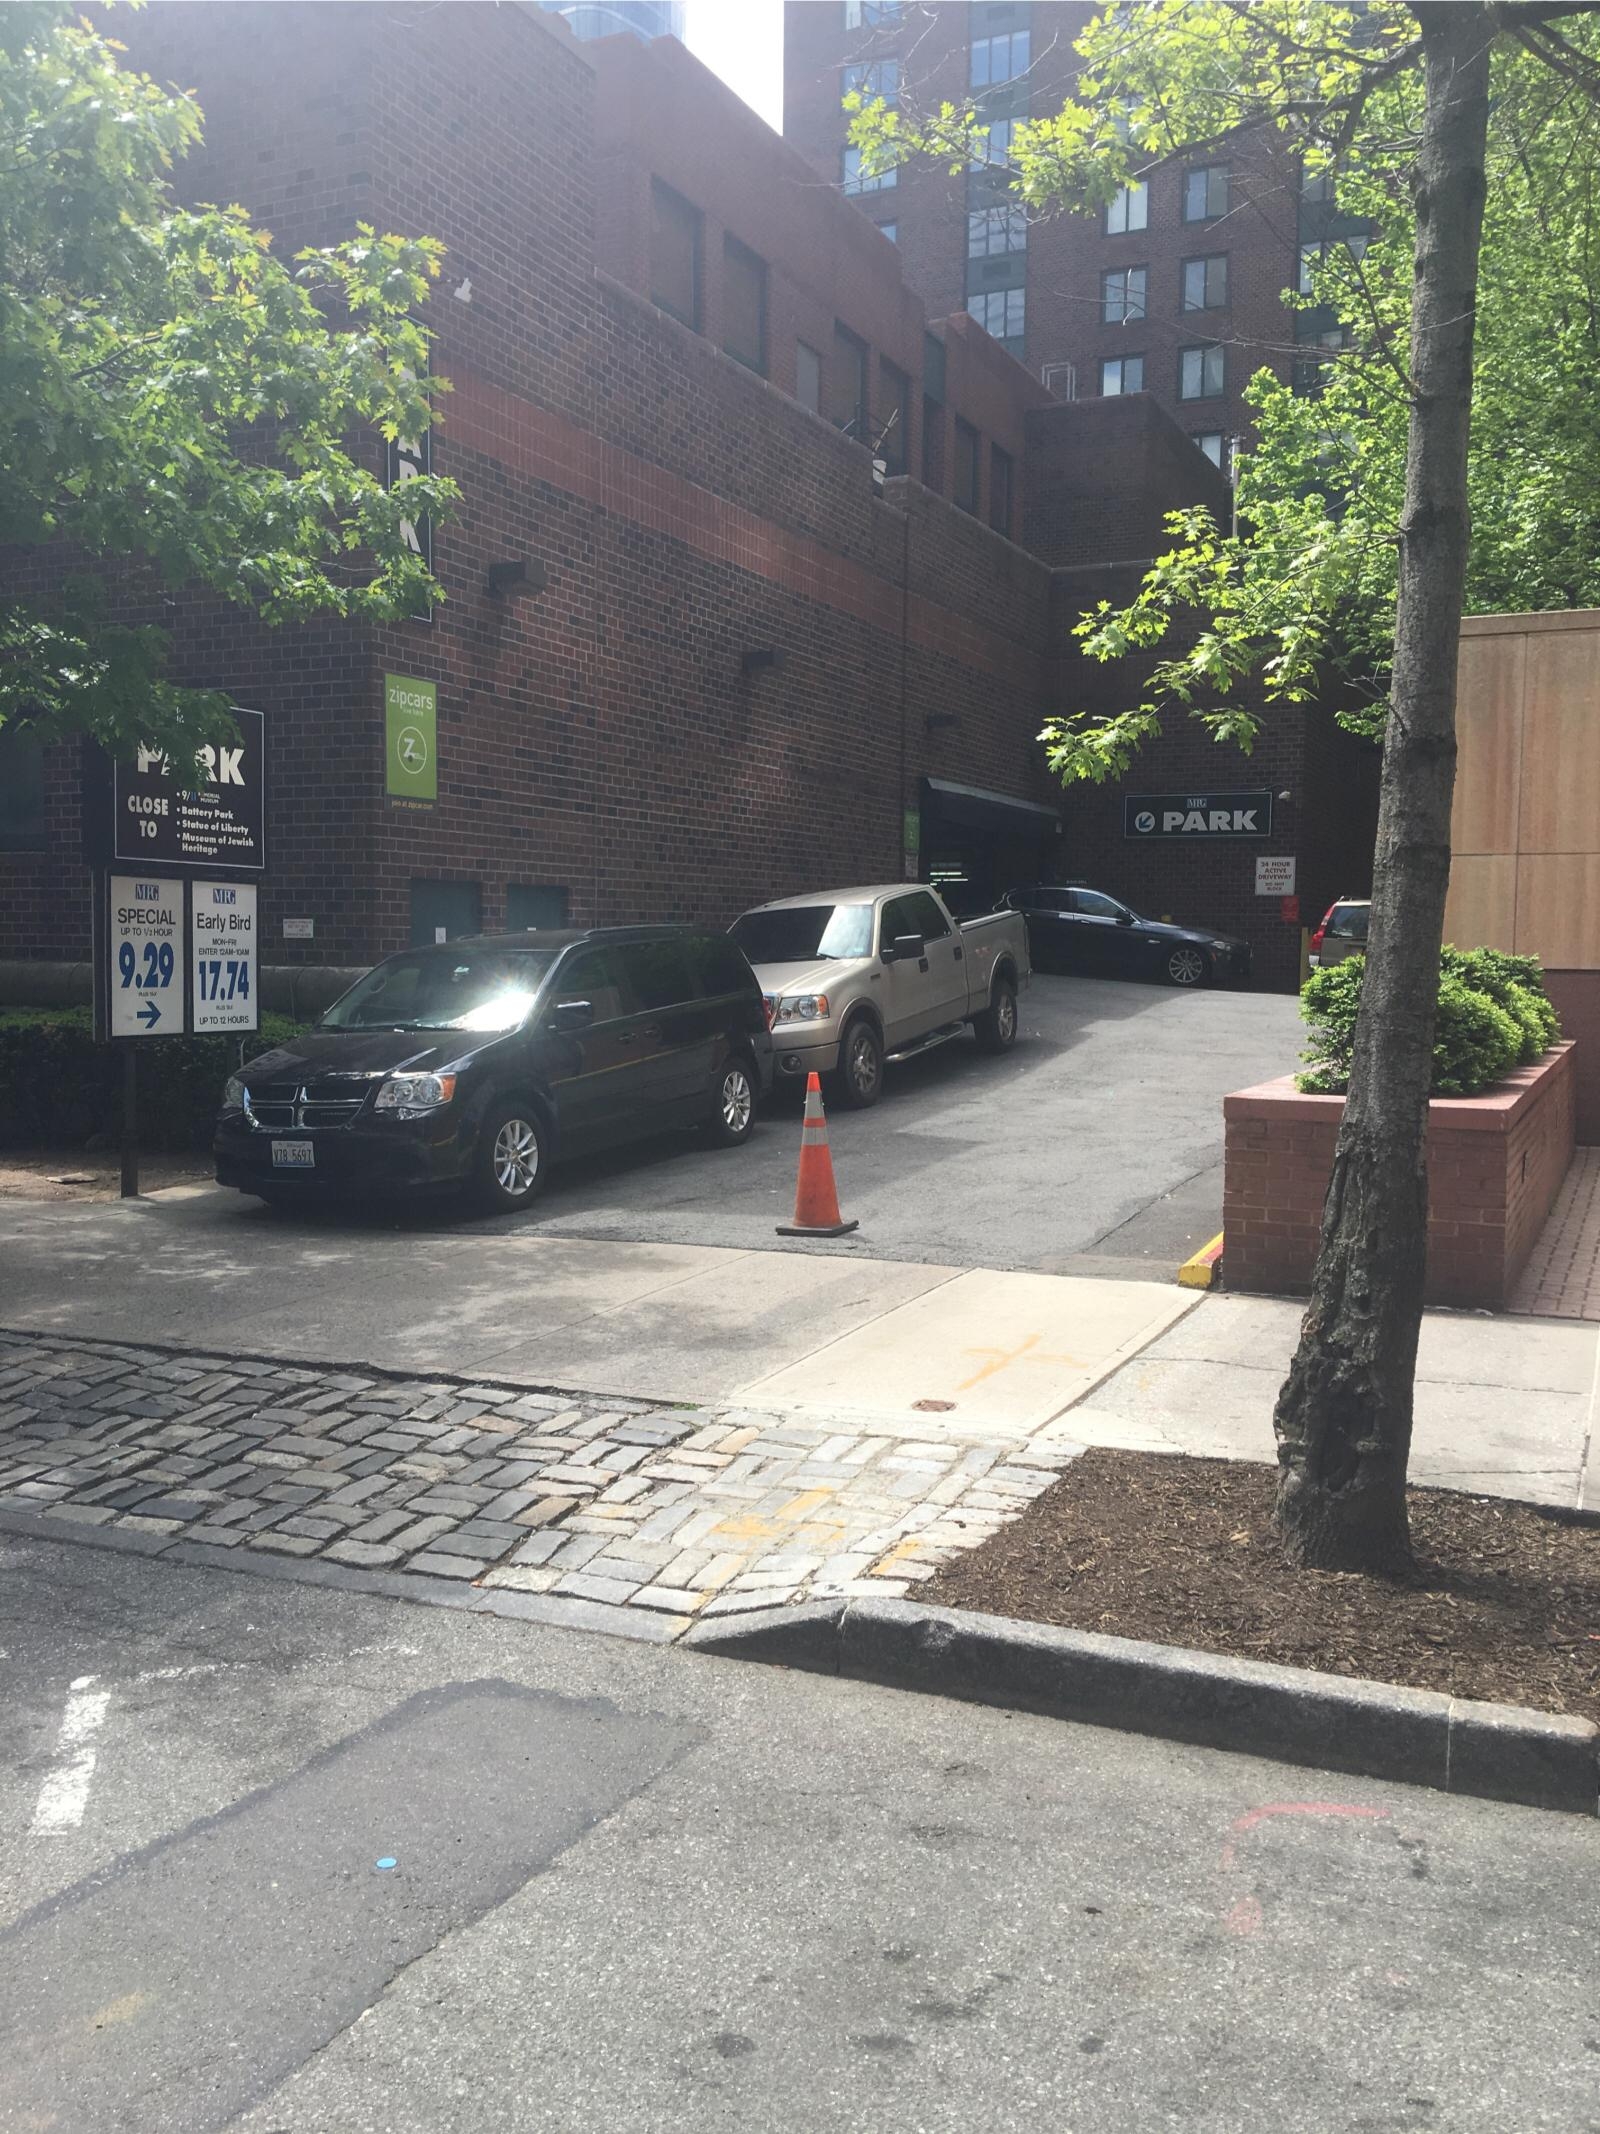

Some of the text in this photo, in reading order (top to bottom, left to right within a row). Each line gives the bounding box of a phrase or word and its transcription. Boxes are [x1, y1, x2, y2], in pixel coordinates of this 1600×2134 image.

[389, 685, 433, 710] zipcars
[137, 739, 246, 786] PRK
[127, 795, 169, 816] CLOSE
[181, 806, 234, 820] Battery Park
[139, 820, 157, 838] TO
[182, 820, 249, 836] Statue of Liberty
[1163, 809, 1258, 832] PARK
[182, 832, 254, 847] Museum of Jewish
[182, 843, 218, 856] Heritage
[117, 907, 176, 925] SPECIAL
[196, 912, 251, 933] Early Bird
[120, 927, 131, 936] UP
[132, 927, 142, 936] TO
[154, 928, 173, 937] HOUR
[212, 937, 237, 946] MON-FRI
[199, 947, 218, 956] ENTER
[118, 941, 175, 989] 9.29
[198, 960, 250, 1001] 17.74
[199, 1015, 250, 1025] UP TO 12 HOURS
